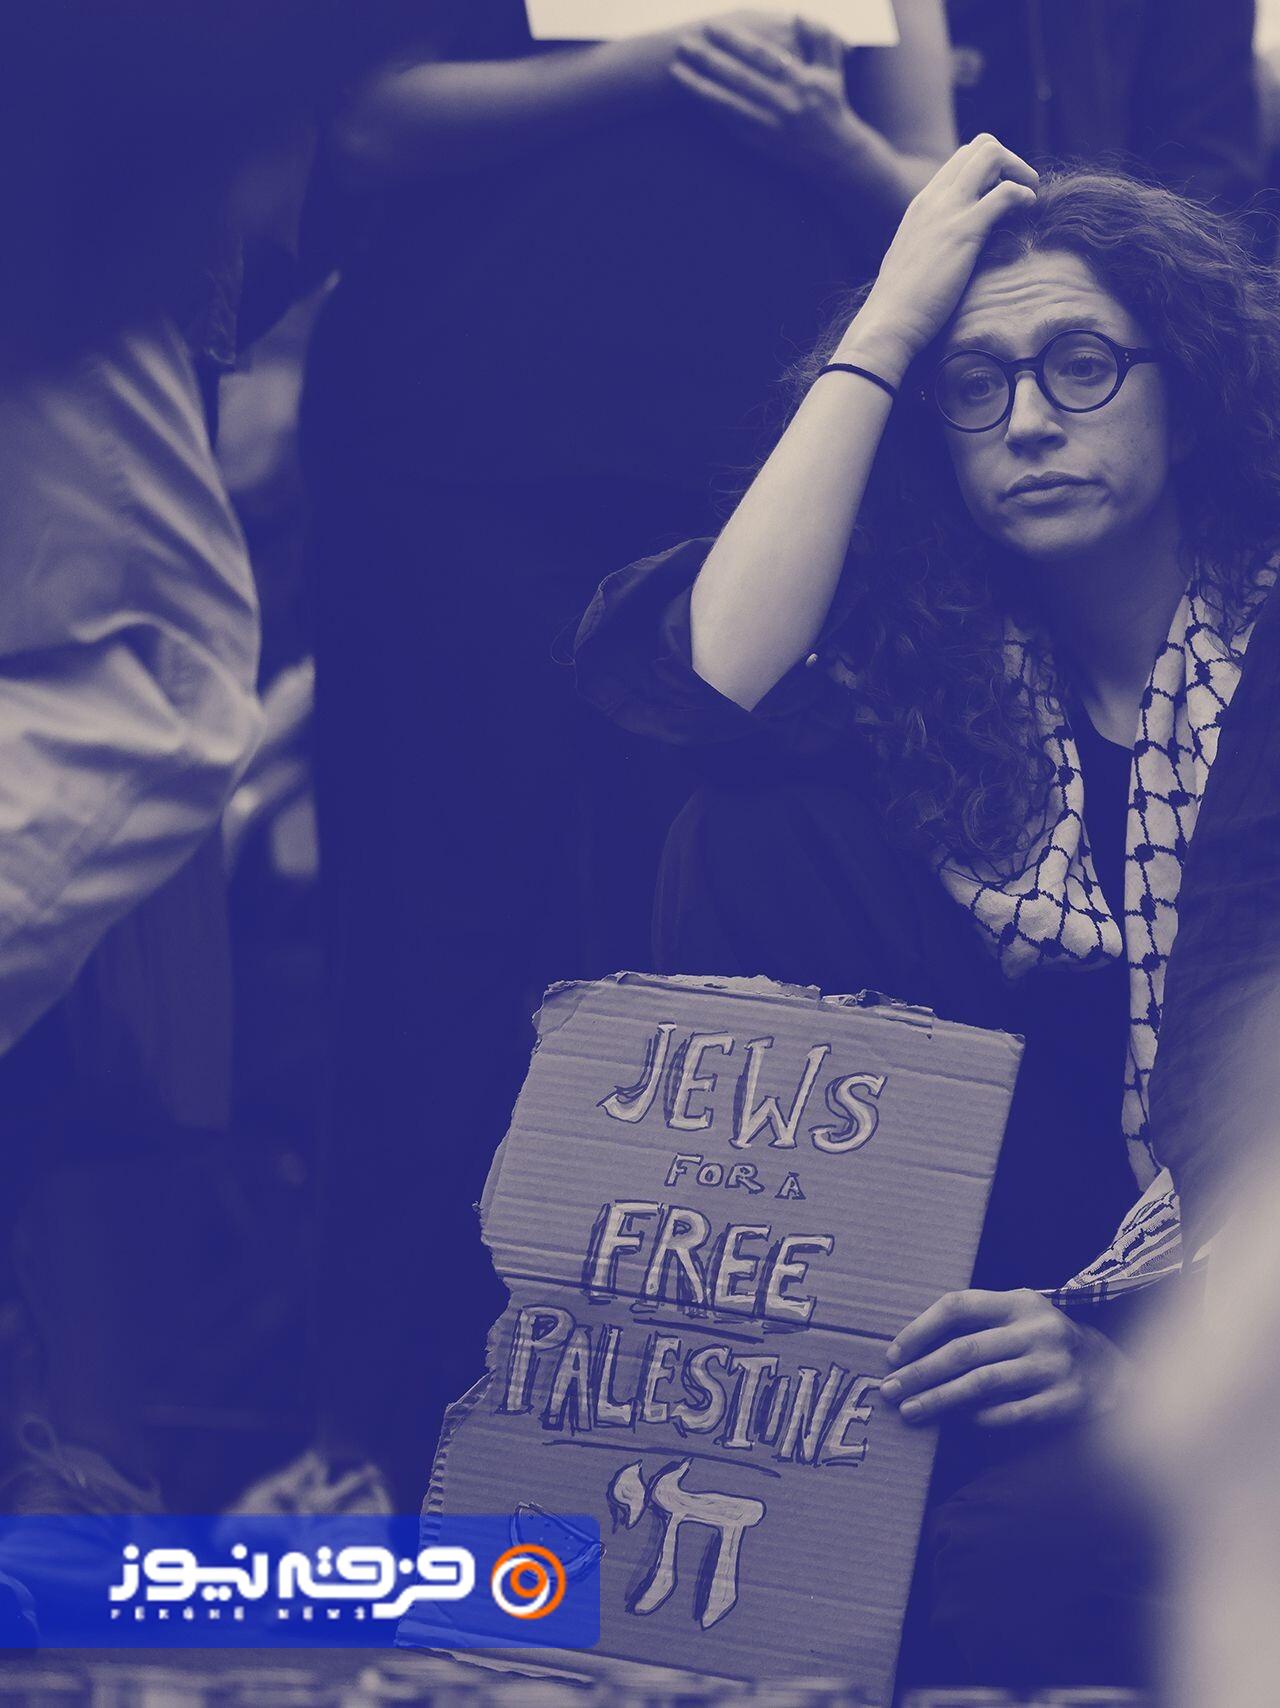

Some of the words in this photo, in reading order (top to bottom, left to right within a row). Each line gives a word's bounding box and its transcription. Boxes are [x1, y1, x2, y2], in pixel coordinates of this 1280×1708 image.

[597, 1021, 886, 1154] JEWS
[664, 1153, 764, 1195] FOR
[775, 1172, 807, 1201] A
[584, 1199, 835, 1331] FREE
[499, 1304, 885, 1467] PALESTINE
[607, 1457, 767, 1631] חי
